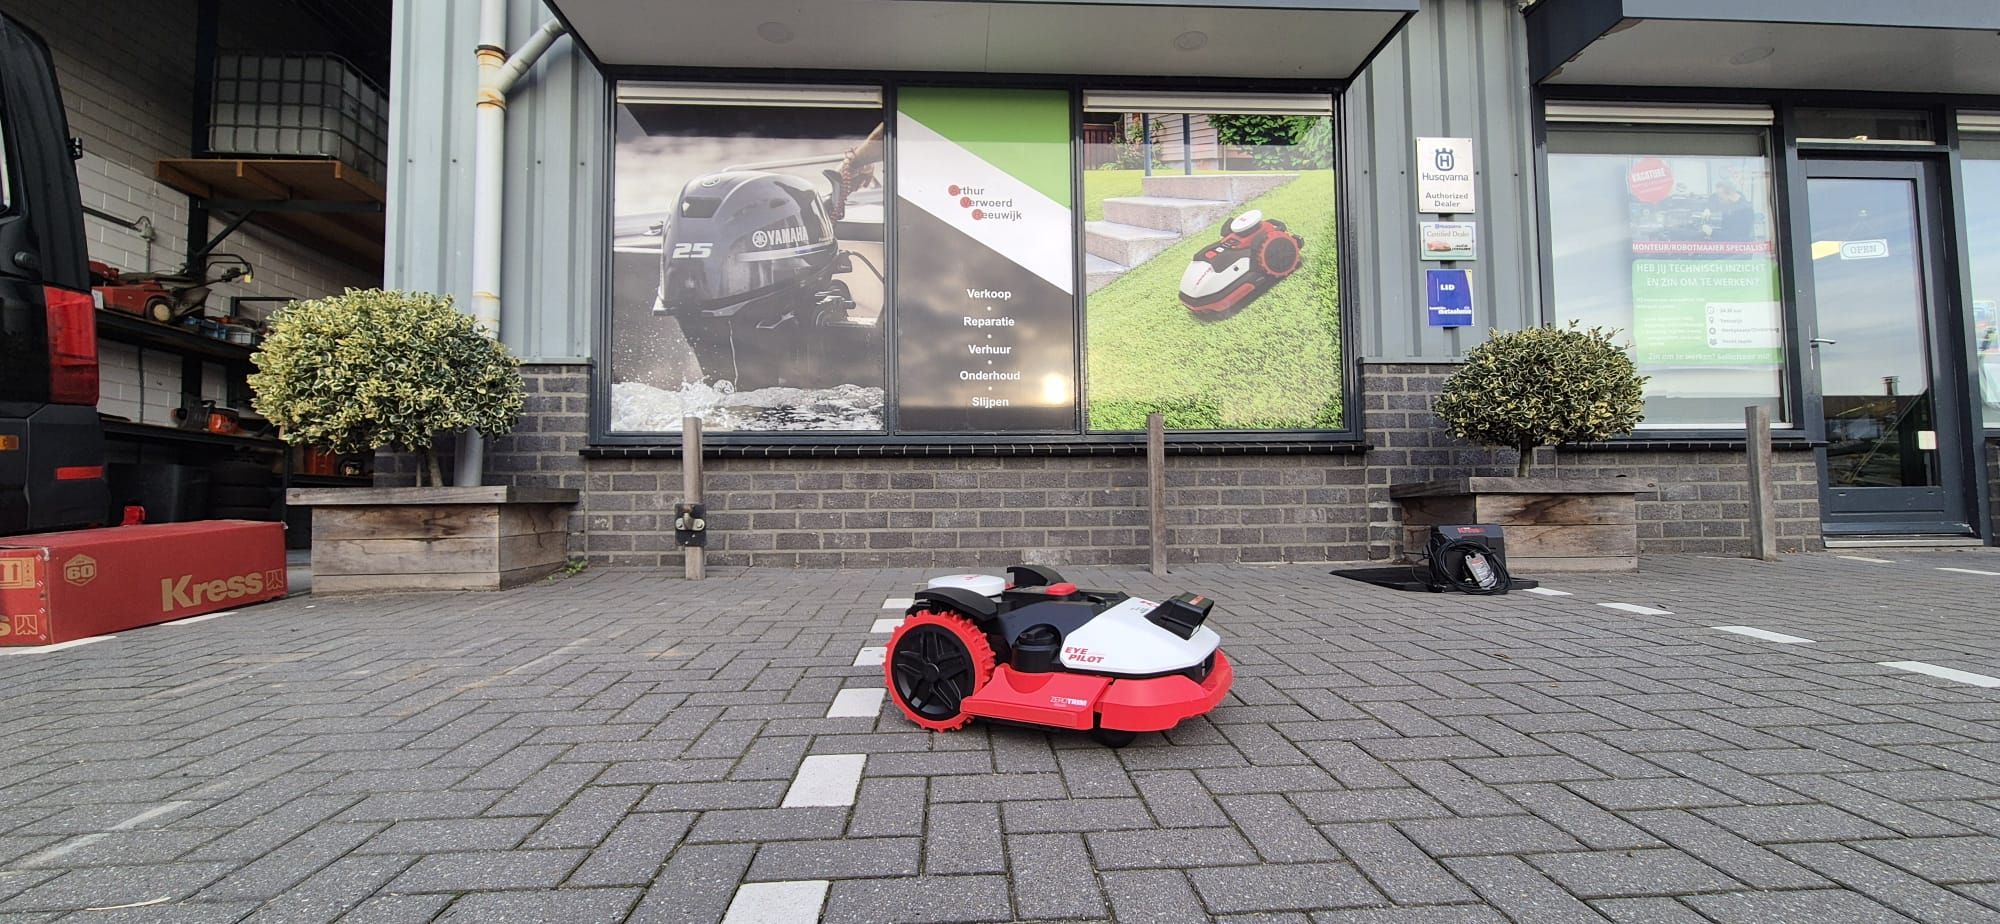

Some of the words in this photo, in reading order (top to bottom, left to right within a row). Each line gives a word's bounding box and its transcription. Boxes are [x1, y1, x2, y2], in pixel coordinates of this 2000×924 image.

[1422, 172, 1469, 182] Husqvarna
[1425, 191, 1469, 199] Authorized
[767, 226, 809, 246] YAMAHA
[672, 242, 713, 259] 25
[1850, 245, 1877, 254] OPEN
[1636, 263, 1655, 273] HEB
[1669, 263, 1723, 273] TECHNISCH
[1725, 263, 1767, 273] INZICHT
[1647, 277, 1659, 287] EN
[1661, 277, 1677, 287] ZIN
[1679, 277, 1697, 287] OM
[1701, 277, 1712, 287] TE
[966, 288, 1012, 301] Verkoop
[963, 316, 1015, 328] Reparatie
[968, 344, 1012, 355] Verhuur
[959, 370, 1020, 381] Onderhoud
[971, 396, 1009, 409] Slijpen
[66, 564, 95, 580] 60
[160, 572, 264, 612] Kress
[1064, 646, 1089, 655] EYE
[1068, 654, 1105, 663] PILOT
